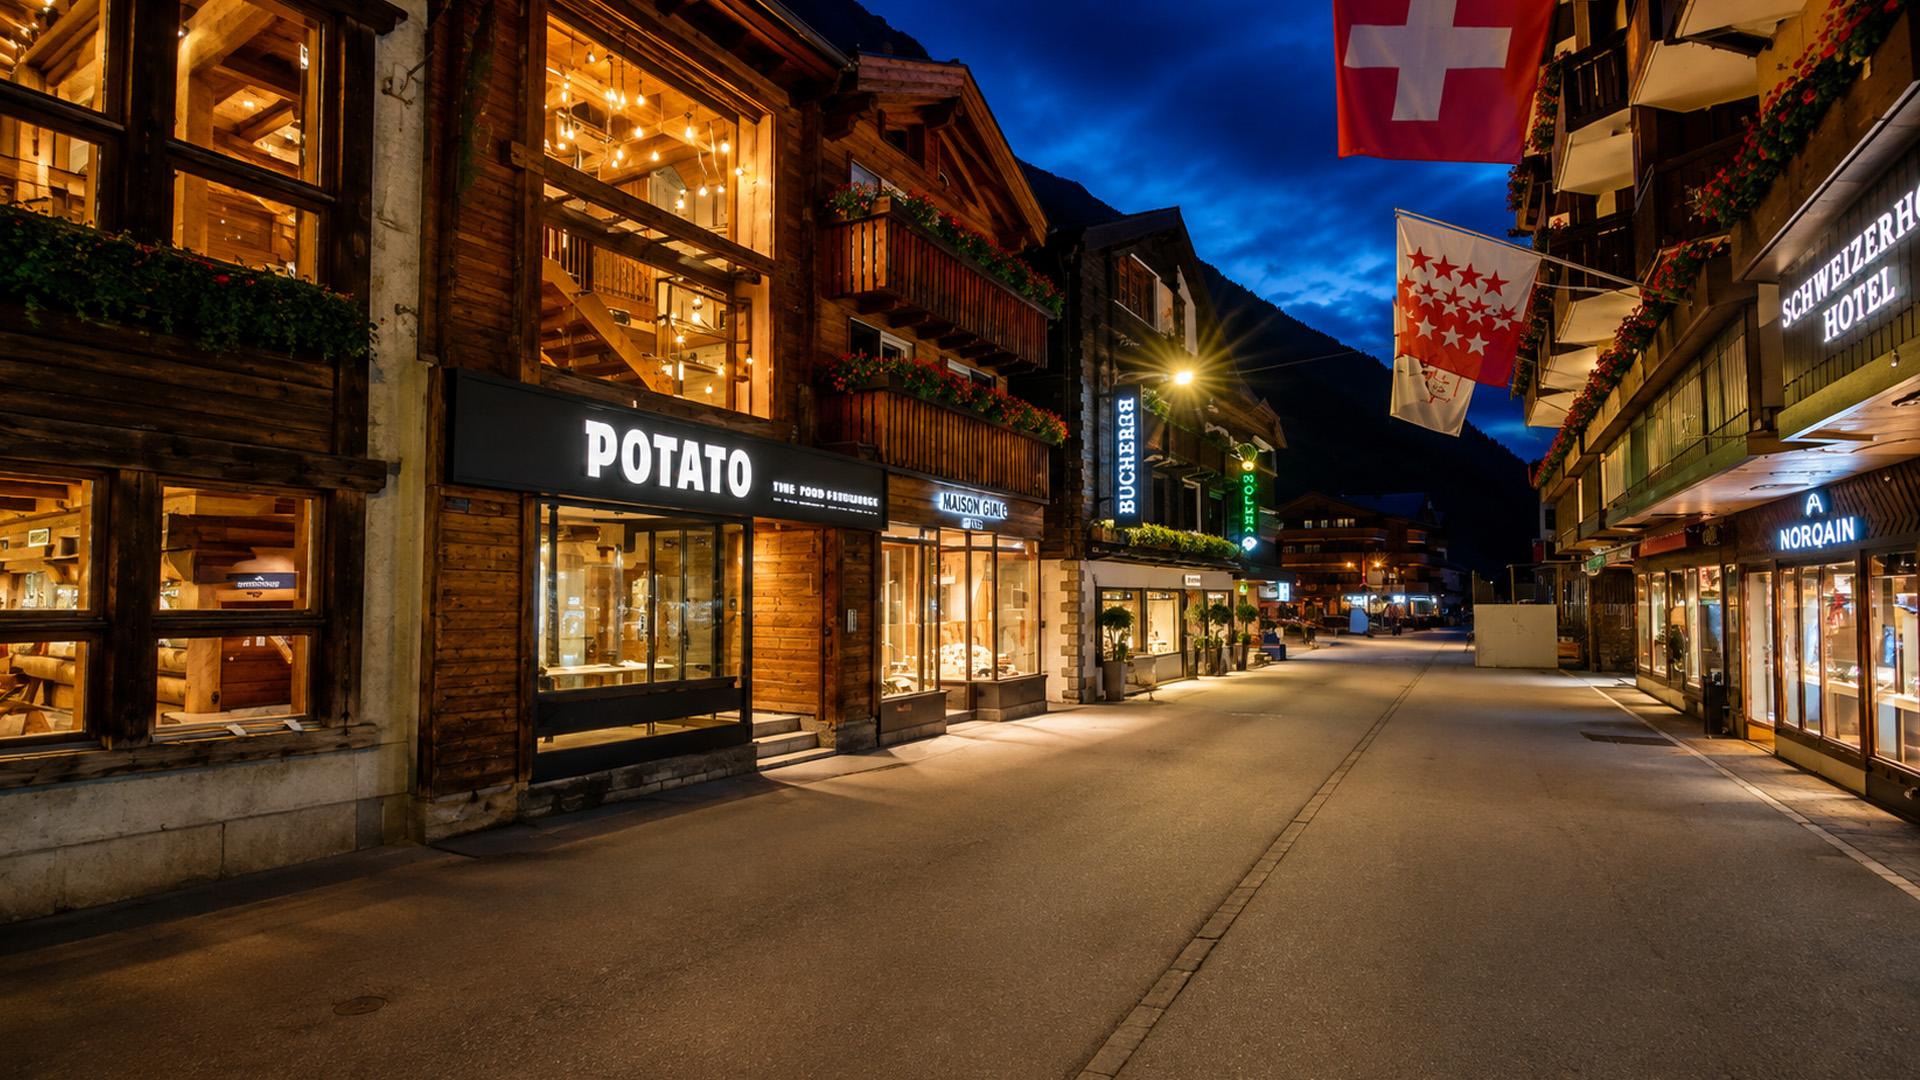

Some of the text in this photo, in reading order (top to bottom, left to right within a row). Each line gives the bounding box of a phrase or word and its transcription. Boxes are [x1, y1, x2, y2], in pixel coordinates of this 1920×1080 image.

[1782, 183, 1920, 328] SCHWEIZERH
[1822, 266, 1896, 343] HOTEL
[585, 419, 752, 498] POTATO
[942, 493, 980, 514] MAISON
[1780, 516, 1855, 550] NORQAIN
